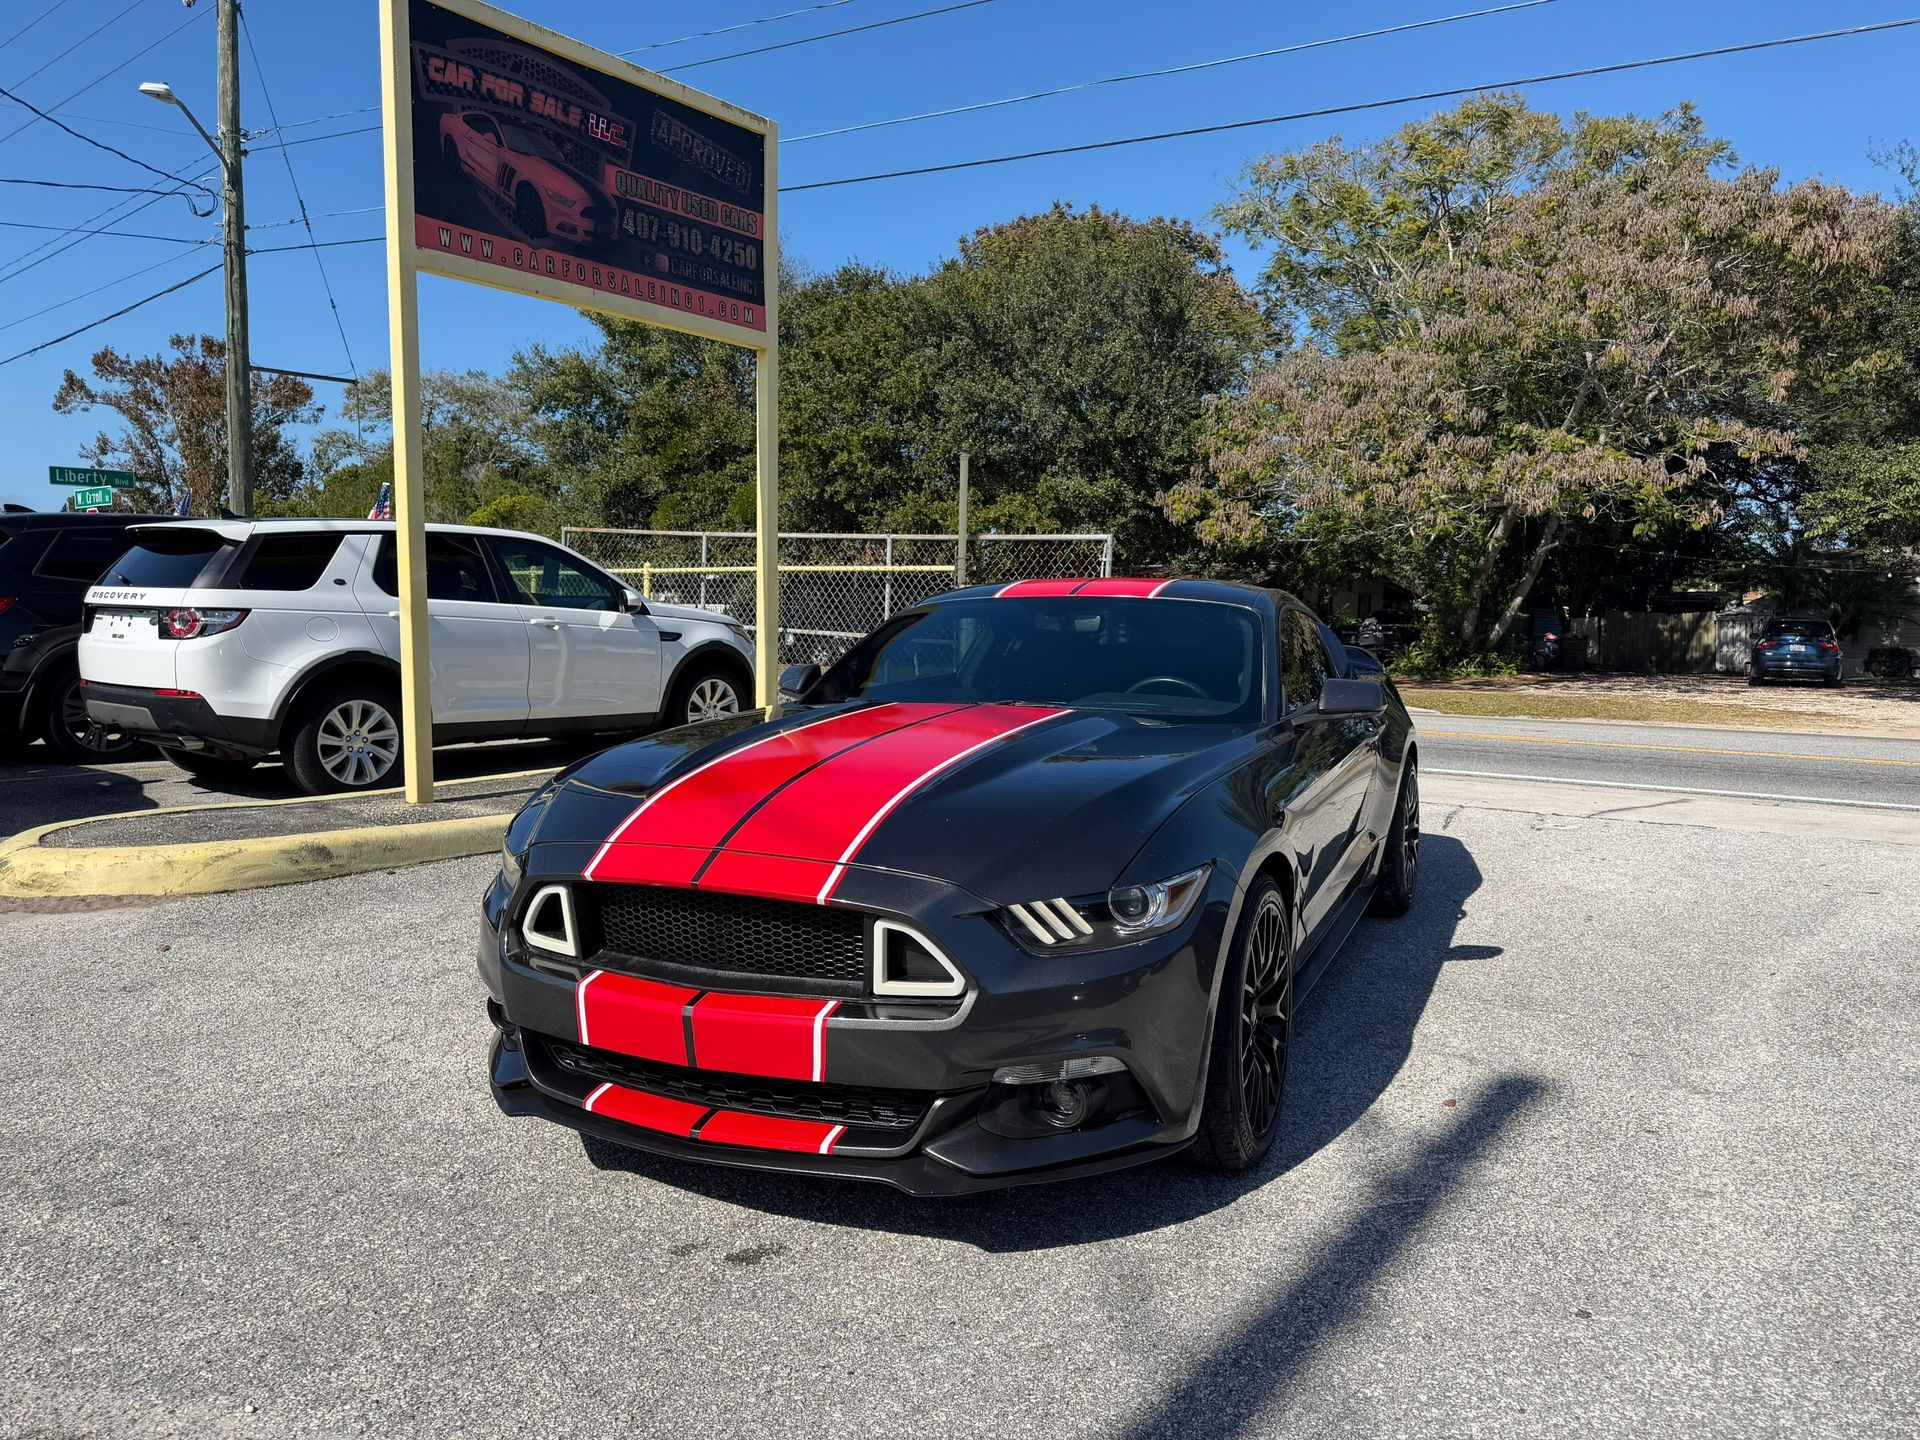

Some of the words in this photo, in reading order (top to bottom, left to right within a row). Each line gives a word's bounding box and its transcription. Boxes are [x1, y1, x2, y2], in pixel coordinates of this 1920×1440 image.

[428, 56, 474, 91] CAR
[480, 73, 525, 106] FOR
[530, 91, 582, 128] SALE
[657, 119, 749, 188] APPROVED
[615, 170, 680, 211] QUALITY
[681, 191, 719, 222] USED
[720, 204, 757, 234] CARS
[622, 207, 758, 271] 407-910-4250
[55, 469, 108, 486] Liberty
[114, 478, 129, 486] Blvd
[92, 591, 147, 600] DISCOVERY
